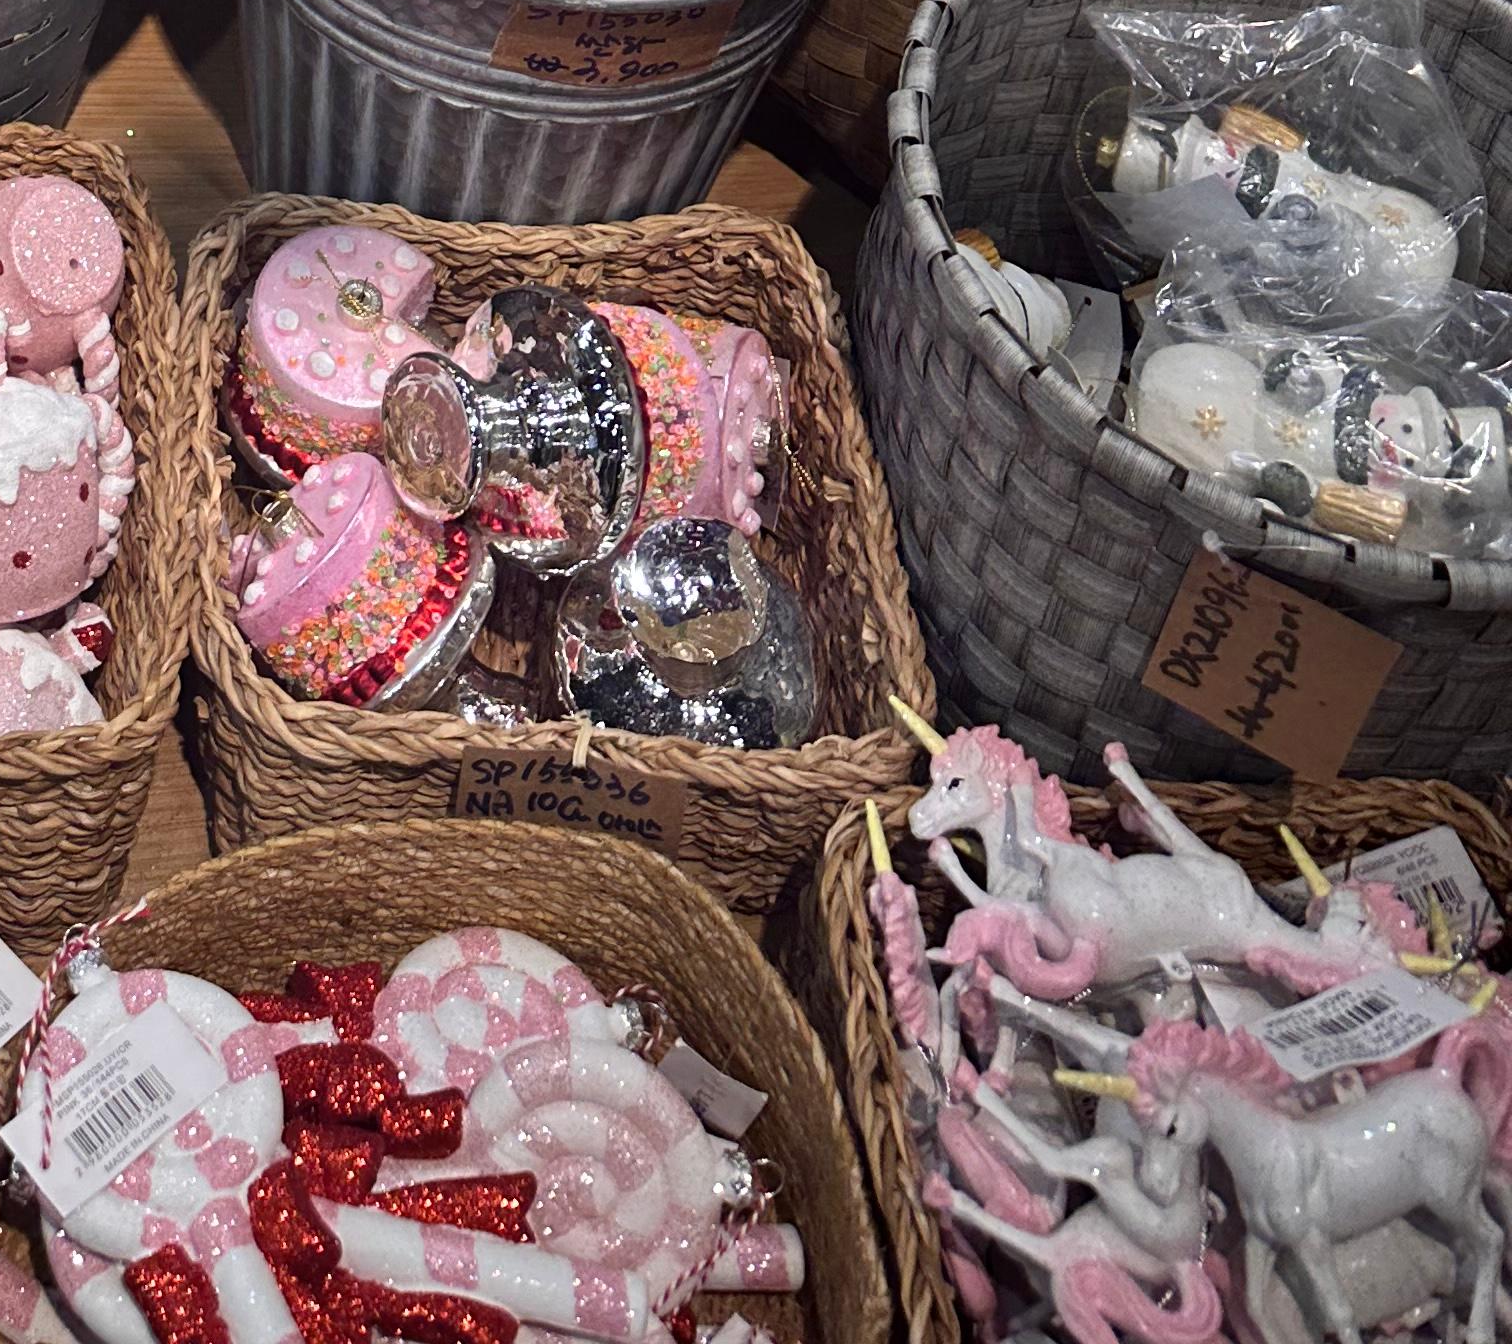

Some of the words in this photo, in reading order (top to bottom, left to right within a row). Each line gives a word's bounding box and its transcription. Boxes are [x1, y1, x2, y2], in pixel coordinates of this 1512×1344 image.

[56, 1099, 80, 1119] PINK
[103, 1144, 131, 1174] MADE
[140, 1112, 171, 1140] CHINA
